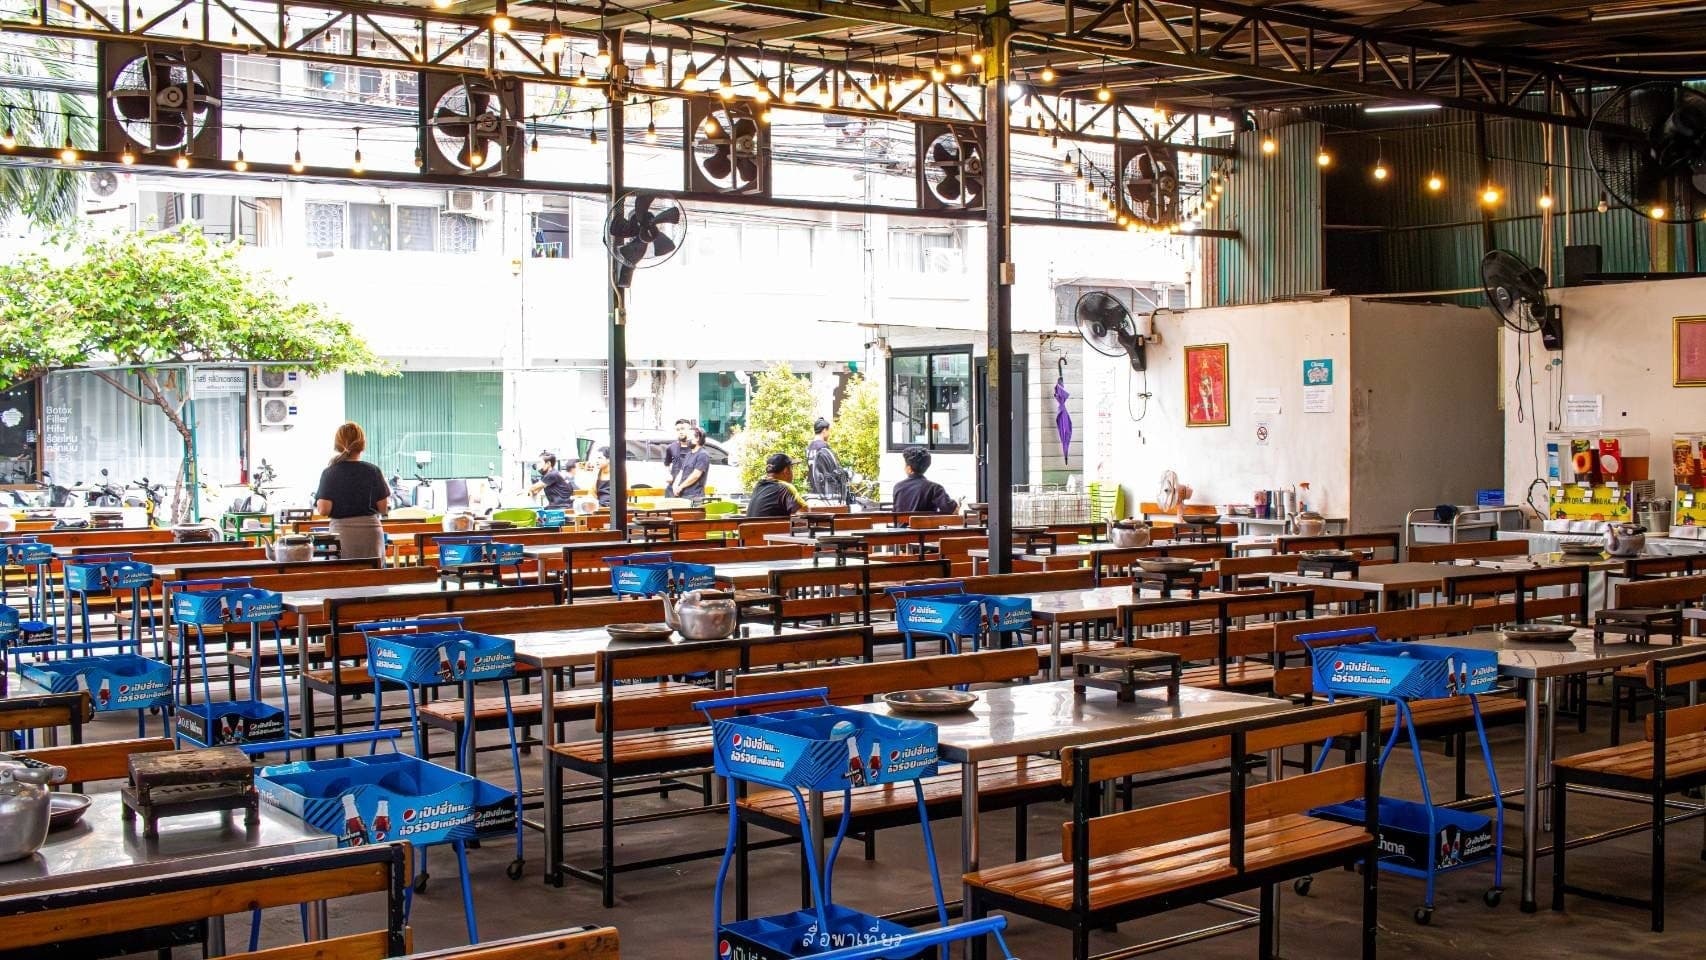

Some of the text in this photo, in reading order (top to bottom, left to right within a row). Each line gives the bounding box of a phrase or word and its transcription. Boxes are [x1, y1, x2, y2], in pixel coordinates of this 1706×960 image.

[46, 406, 72, 414] Botox
[46, 415, 70, 423] Filler
[46, 424, 65, 432] Hifu
